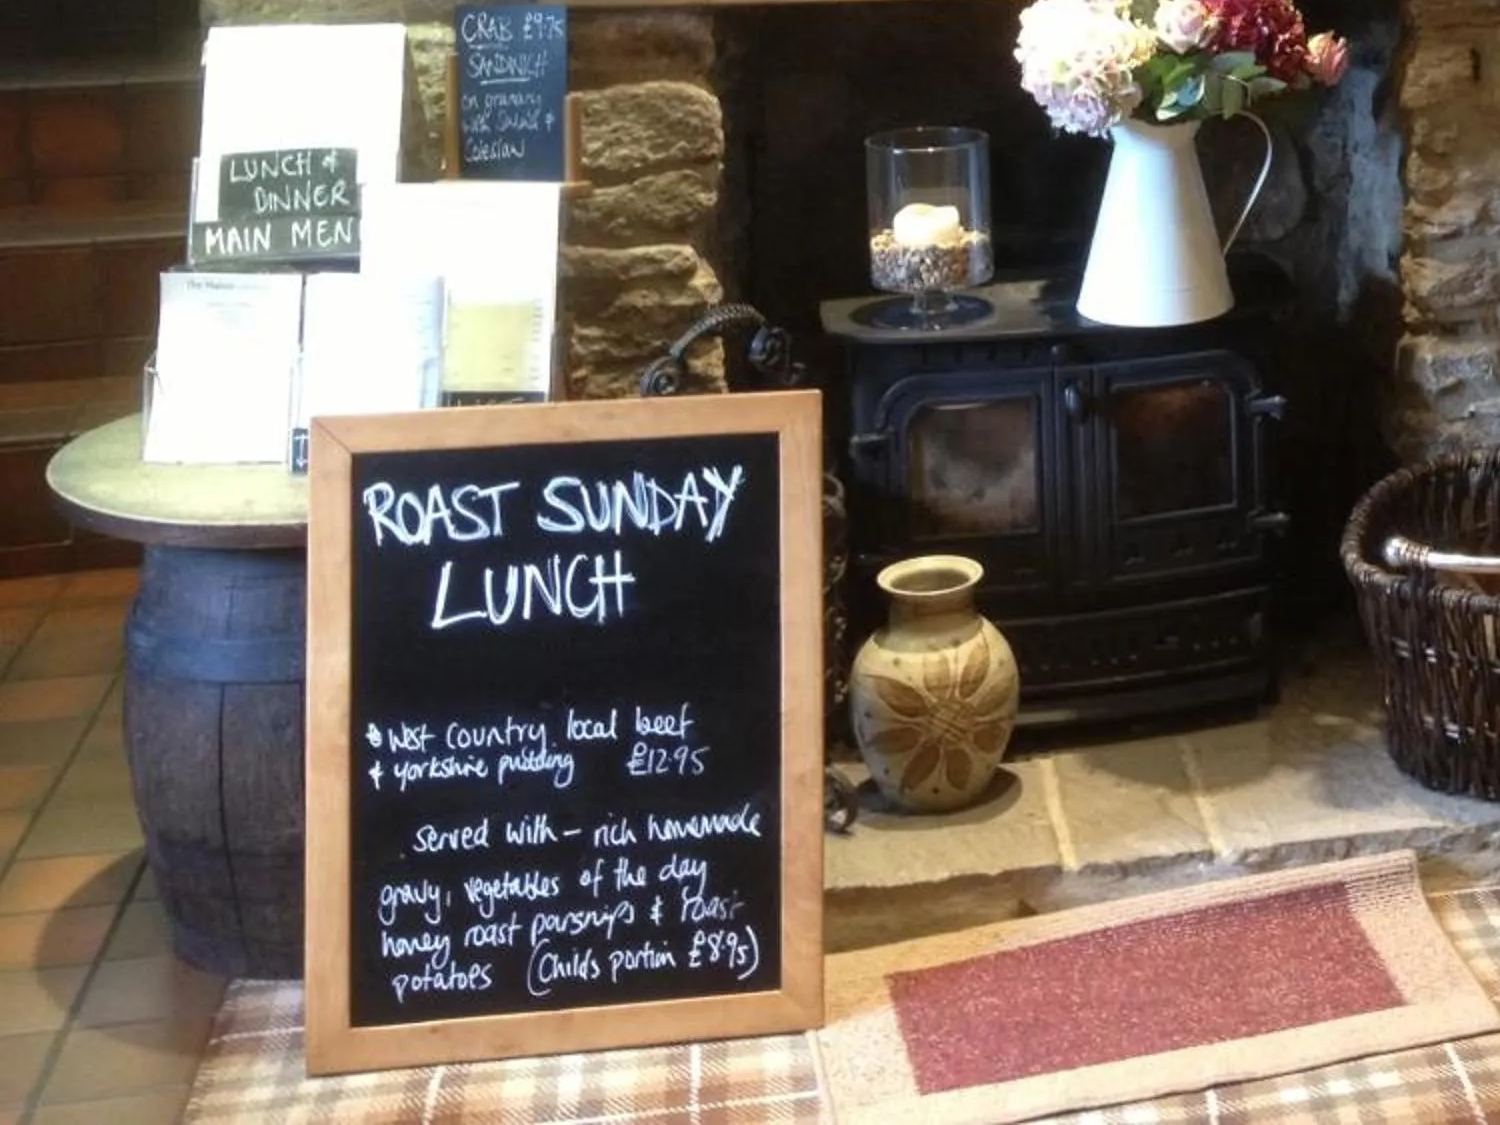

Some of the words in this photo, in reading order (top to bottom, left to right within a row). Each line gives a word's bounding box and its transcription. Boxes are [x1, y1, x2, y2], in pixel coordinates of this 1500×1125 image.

[461, 10, 514, 43] CRAB
[229, 148, 312, 183] LUNCH
[254, 178, 351, 215] DINNER
[204, 221, 272, 256] MAIN
[290, 216, 355, 250] MEN
[363, 479, 520, 547] ROAST
[537, 464, 744, 543] SUNDAY
[432, 550, 636, 629] LUNCH
[566, 709, 618, 741] local
[634, 703, 696, 741] beef
[498, 747, 575, 789] pudding
[626, 742, 712, 777] £12.95
[505, 813, 558, 846] with
[593, 811, 637, 847] rich
[648, 803, 763, 840] homemade
[463, 872, 560, 918] vegetables
[580, 865, 604, 896] of
[613, 856, 647, 892] the
[658, 853, 708, 895] day
[381, 929, 451, 971] honey
[464, 921, 523, 950] roast
[530, 900, 636, 943] parsnips
[392, 962, 493, 1003] potatoes
